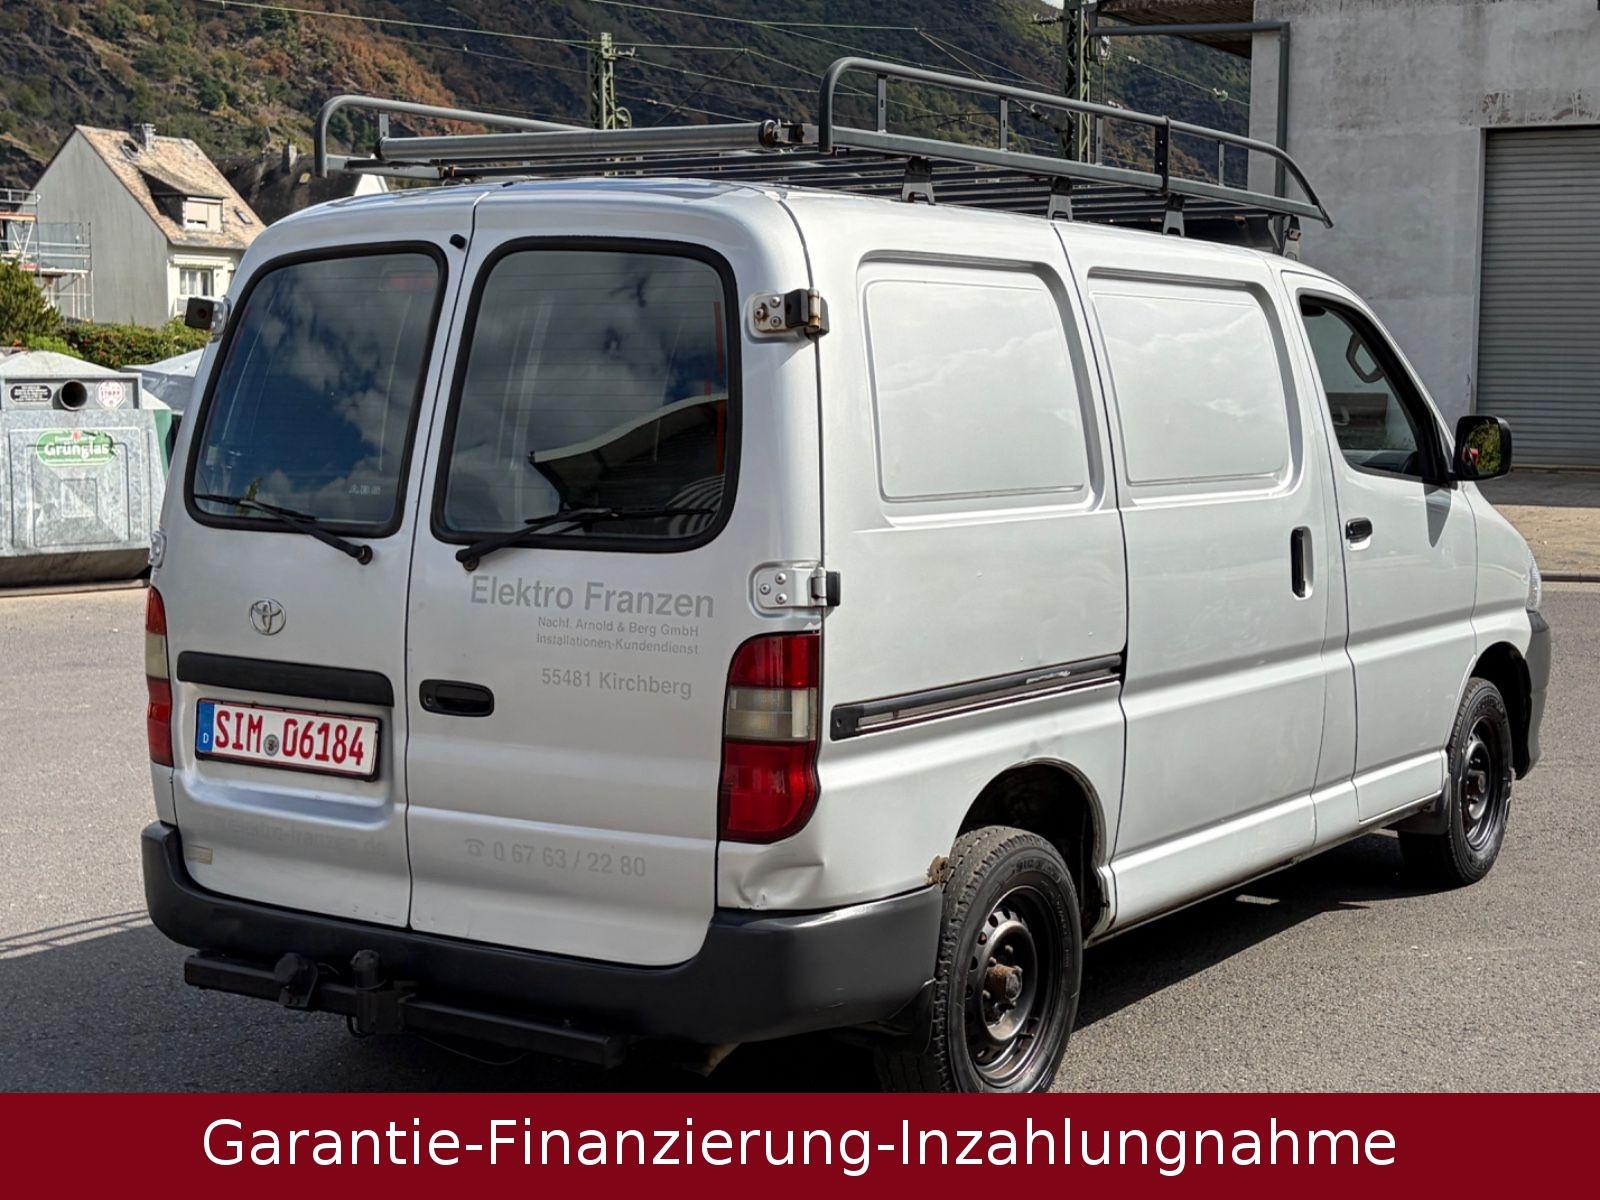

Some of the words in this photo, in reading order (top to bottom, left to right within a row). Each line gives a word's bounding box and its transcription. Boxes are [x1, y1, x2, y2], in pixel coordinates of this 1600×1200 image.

[44, 439, 109, 459] Grünglas
[471, 575, 573, 609] Elektro
[584, 581, 714, 618] Franzen
[576, 618, 614, 632] Arnold
[616, 622, 625, 632] &
[629, 622, 657, 637] Berg
[660, 624, 699, 637] GmbH
[541, 667, 591, 688] 55481
[599, 672, 692, 700] Kirchberg
[203, 732, 209, 744] D
[215, 710, 263, 753] SIM
[282, 718, 364, 766] 06184
[493, 841, 505, 861] 0
[511, 844, 535, 864] 67
[542, 848, 567, 869] 63
[587, 853, 613, 874] 22
[620, 855, 646, 877] 80
